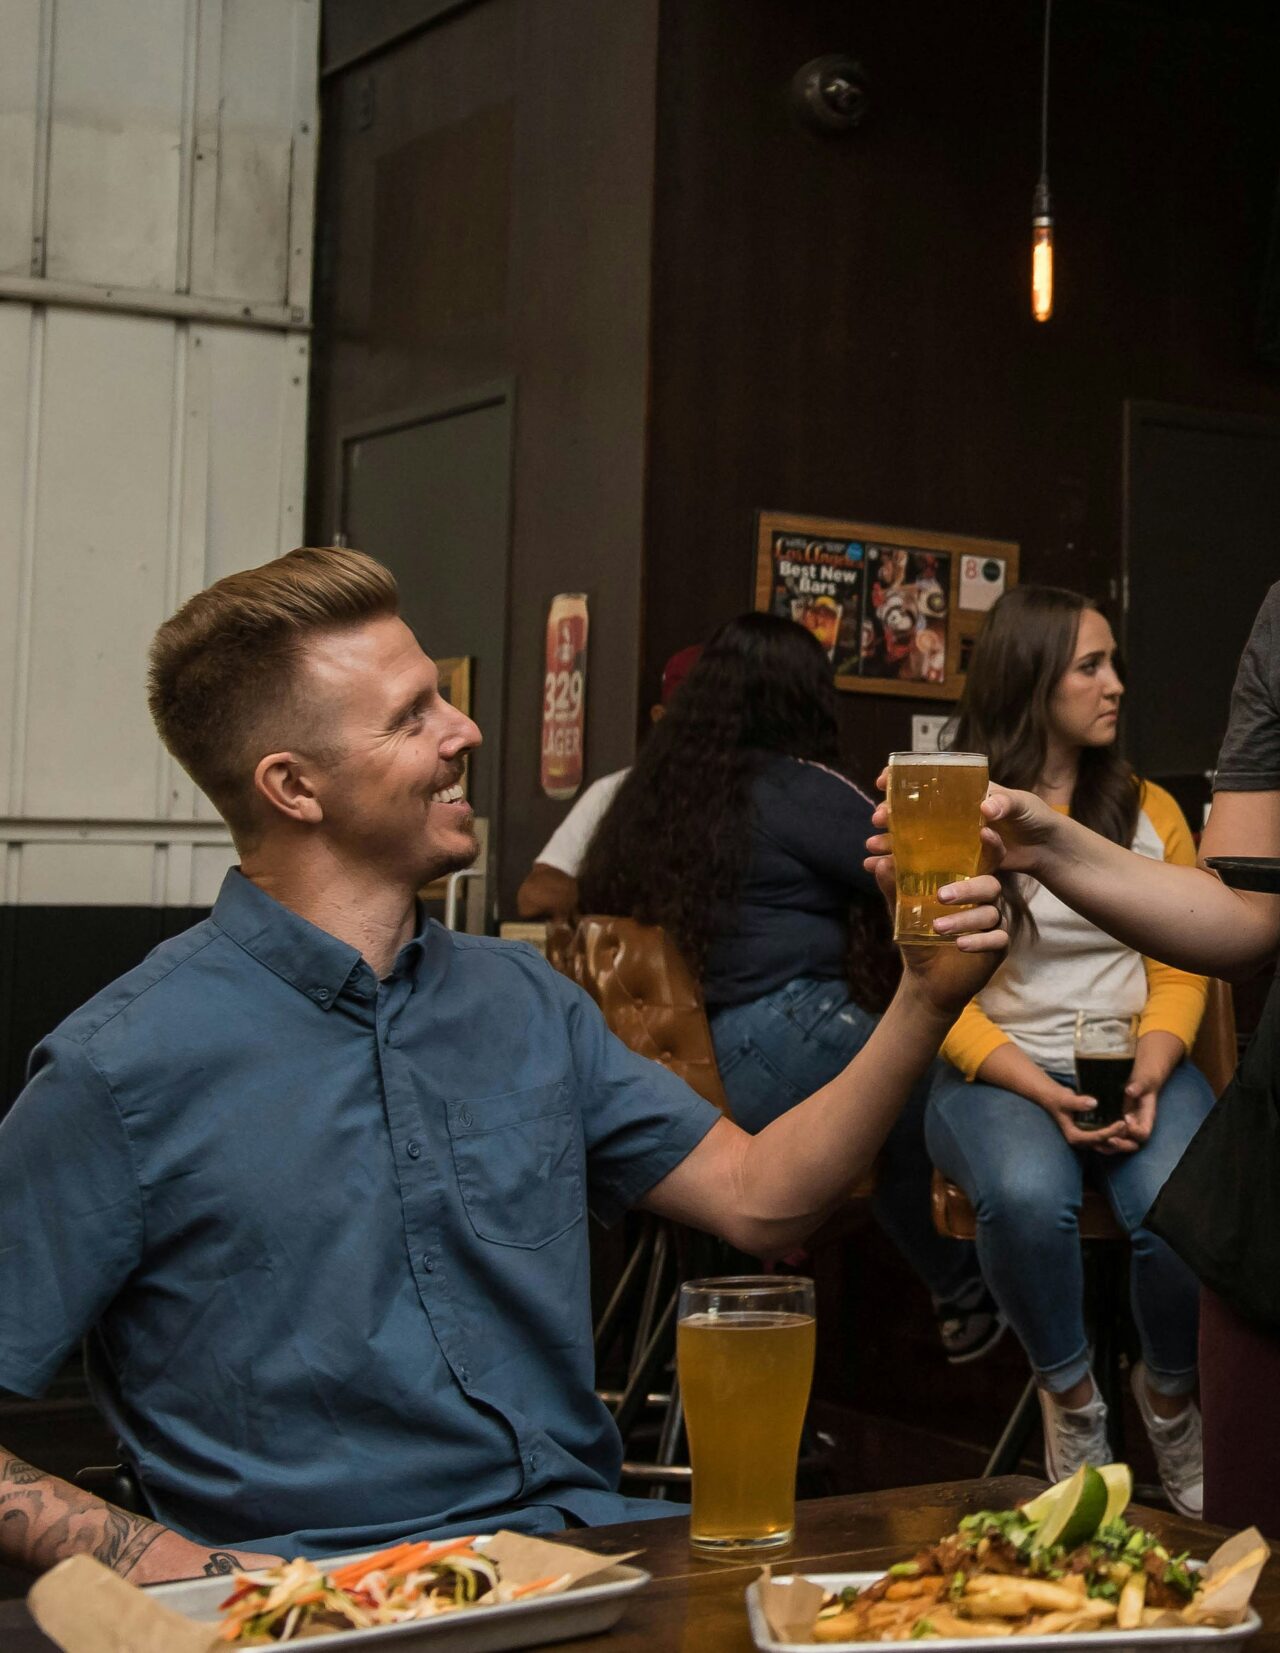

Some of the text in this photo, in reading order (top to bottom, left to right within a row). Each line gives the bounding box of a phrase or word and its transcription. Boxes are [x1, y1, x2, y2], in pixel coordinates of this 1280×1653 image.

[780, 560, 857, 584] Best New
[799, 577, 836, 596] Bars
[544, 670, 582, 721] 329
